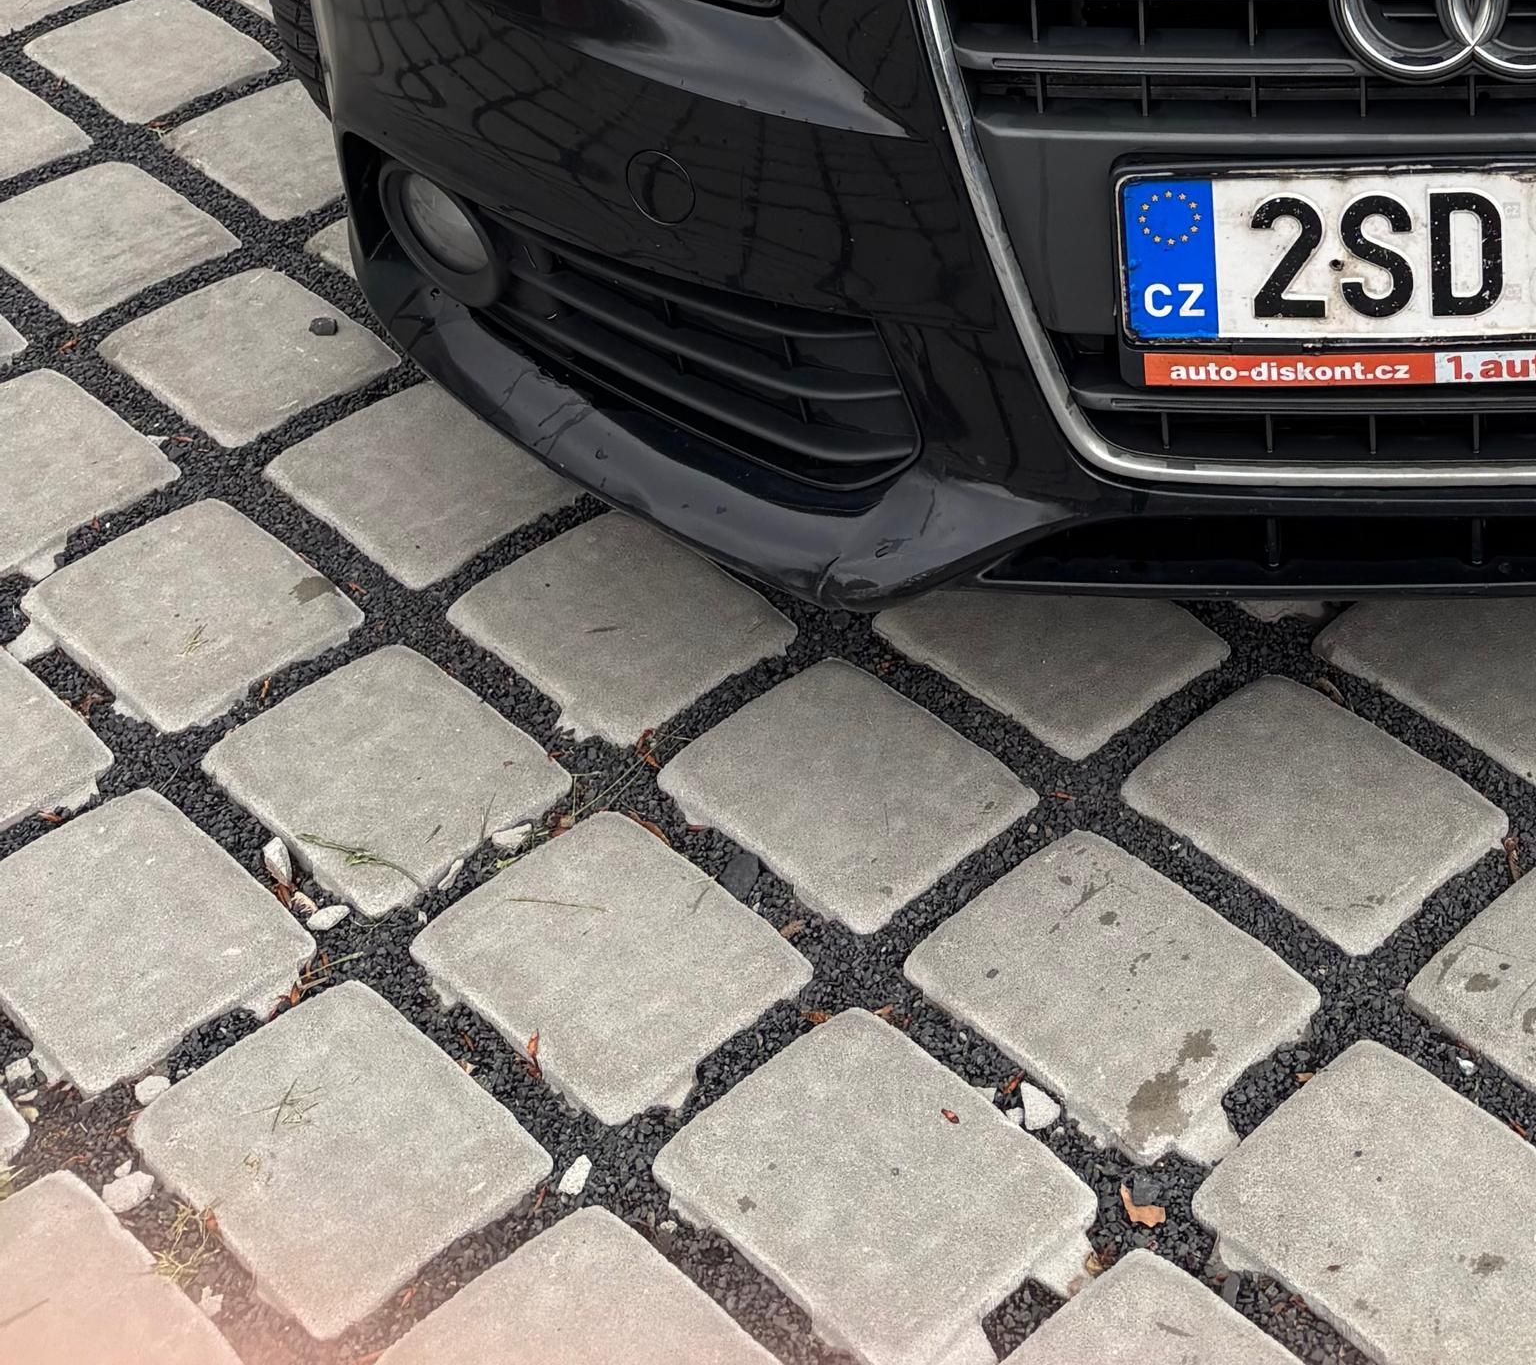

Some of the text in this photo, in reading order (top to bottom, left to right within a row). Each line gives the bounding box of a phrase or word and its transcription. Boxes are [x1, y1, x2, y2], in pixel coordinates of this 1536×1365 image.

[1250, 193, 1504, 319] 2SD
[1143, 283, 1206, 318] CZ
[1170, 362, 1410, 381] auto-diskont.cz
